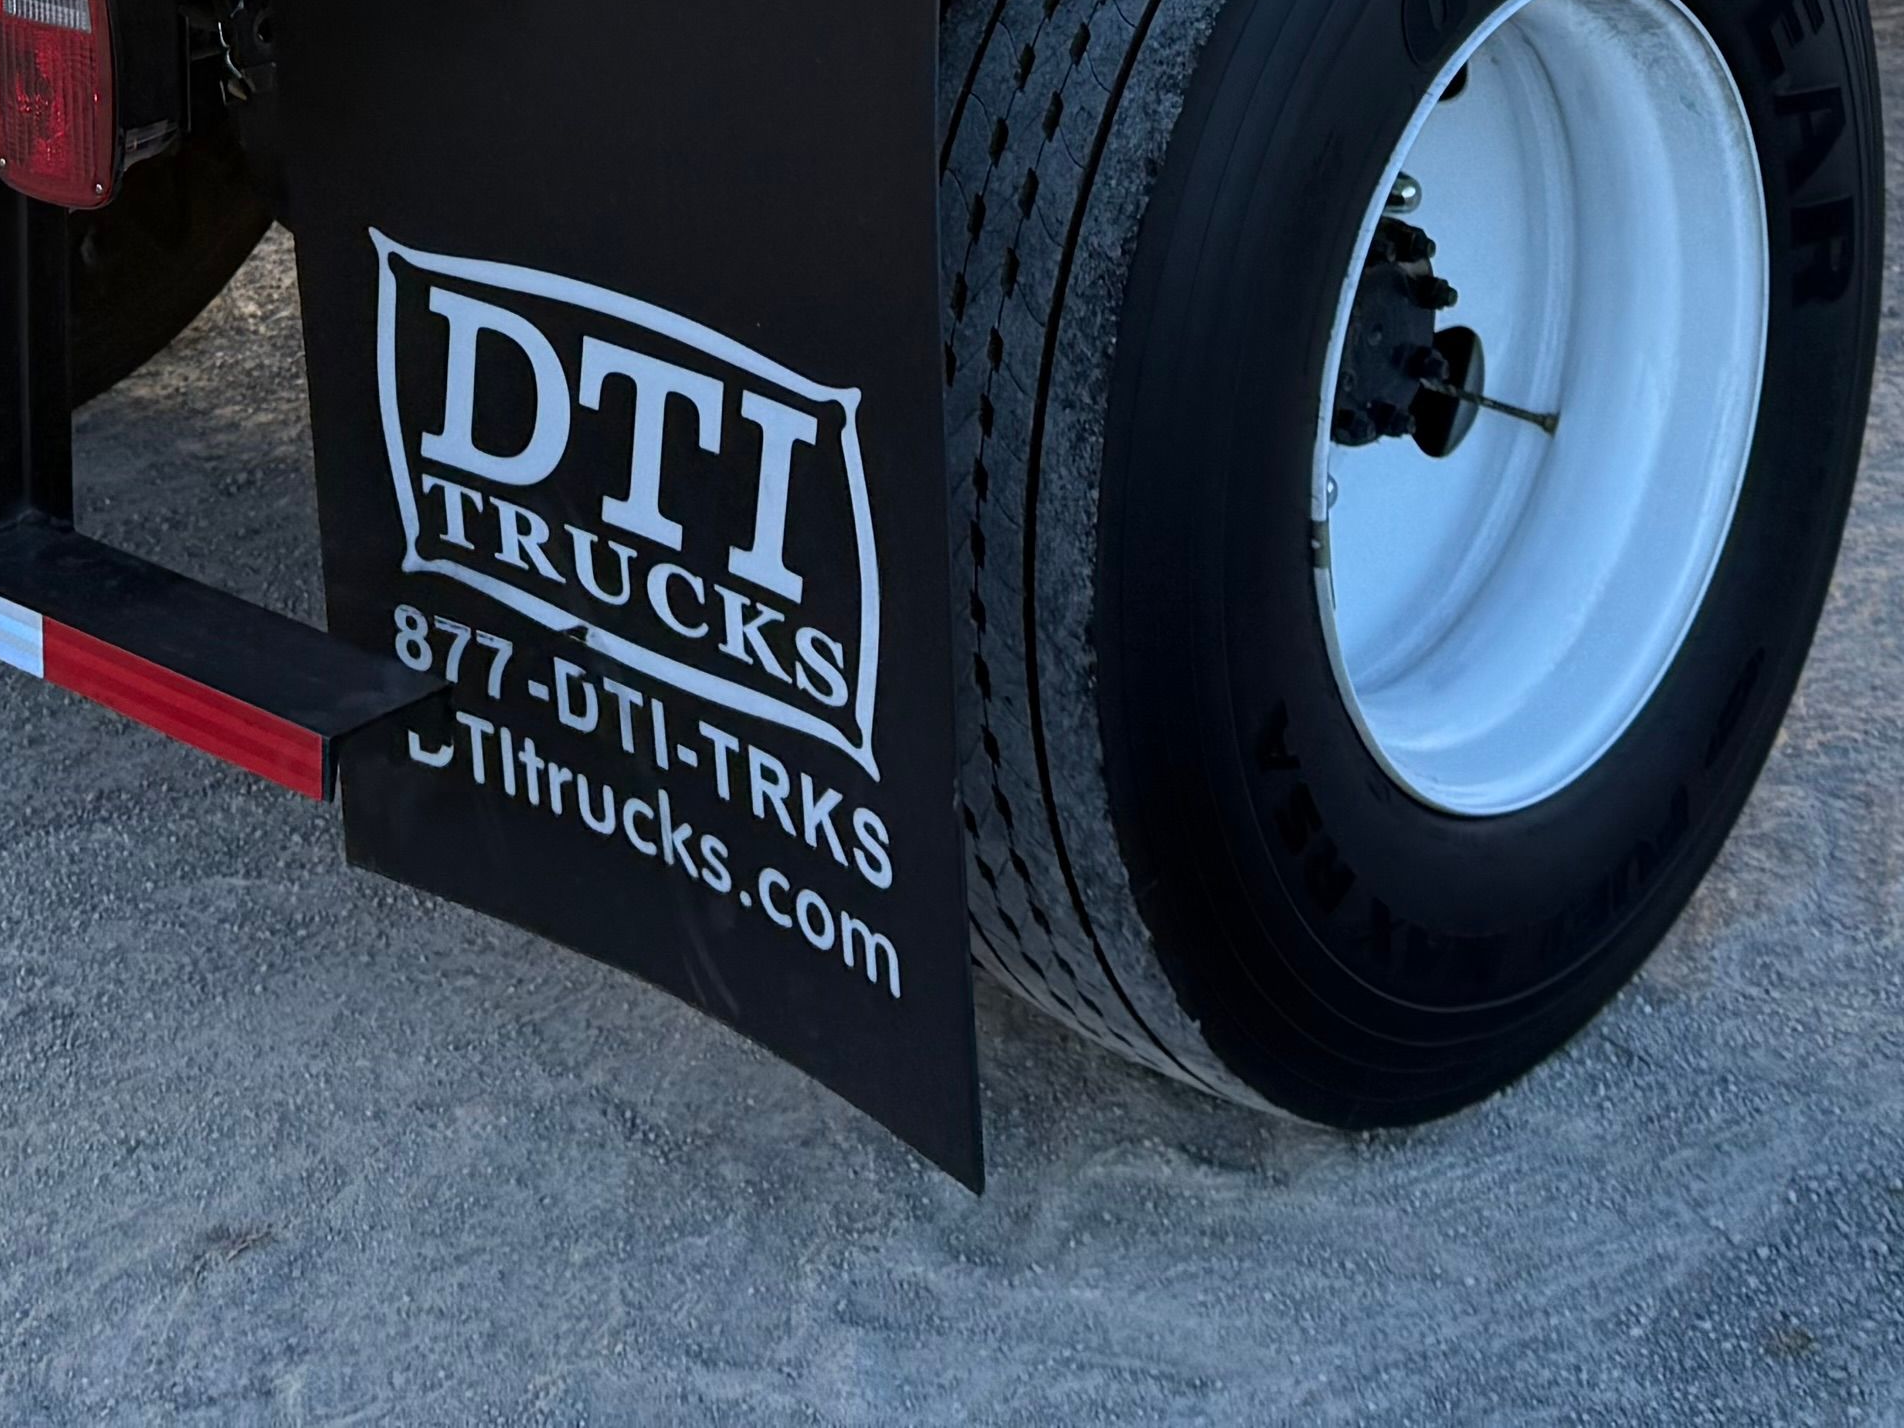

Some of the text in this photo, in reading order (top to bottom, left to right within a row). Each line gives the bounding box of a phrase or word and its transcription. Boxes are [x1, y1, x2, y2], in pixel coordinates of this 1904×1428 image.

[420, 286, 818, 605] DTI
[421, 473, 850, 708] TRUCKS
[393, 604, 894, 890] 877-DTI-TRKS
